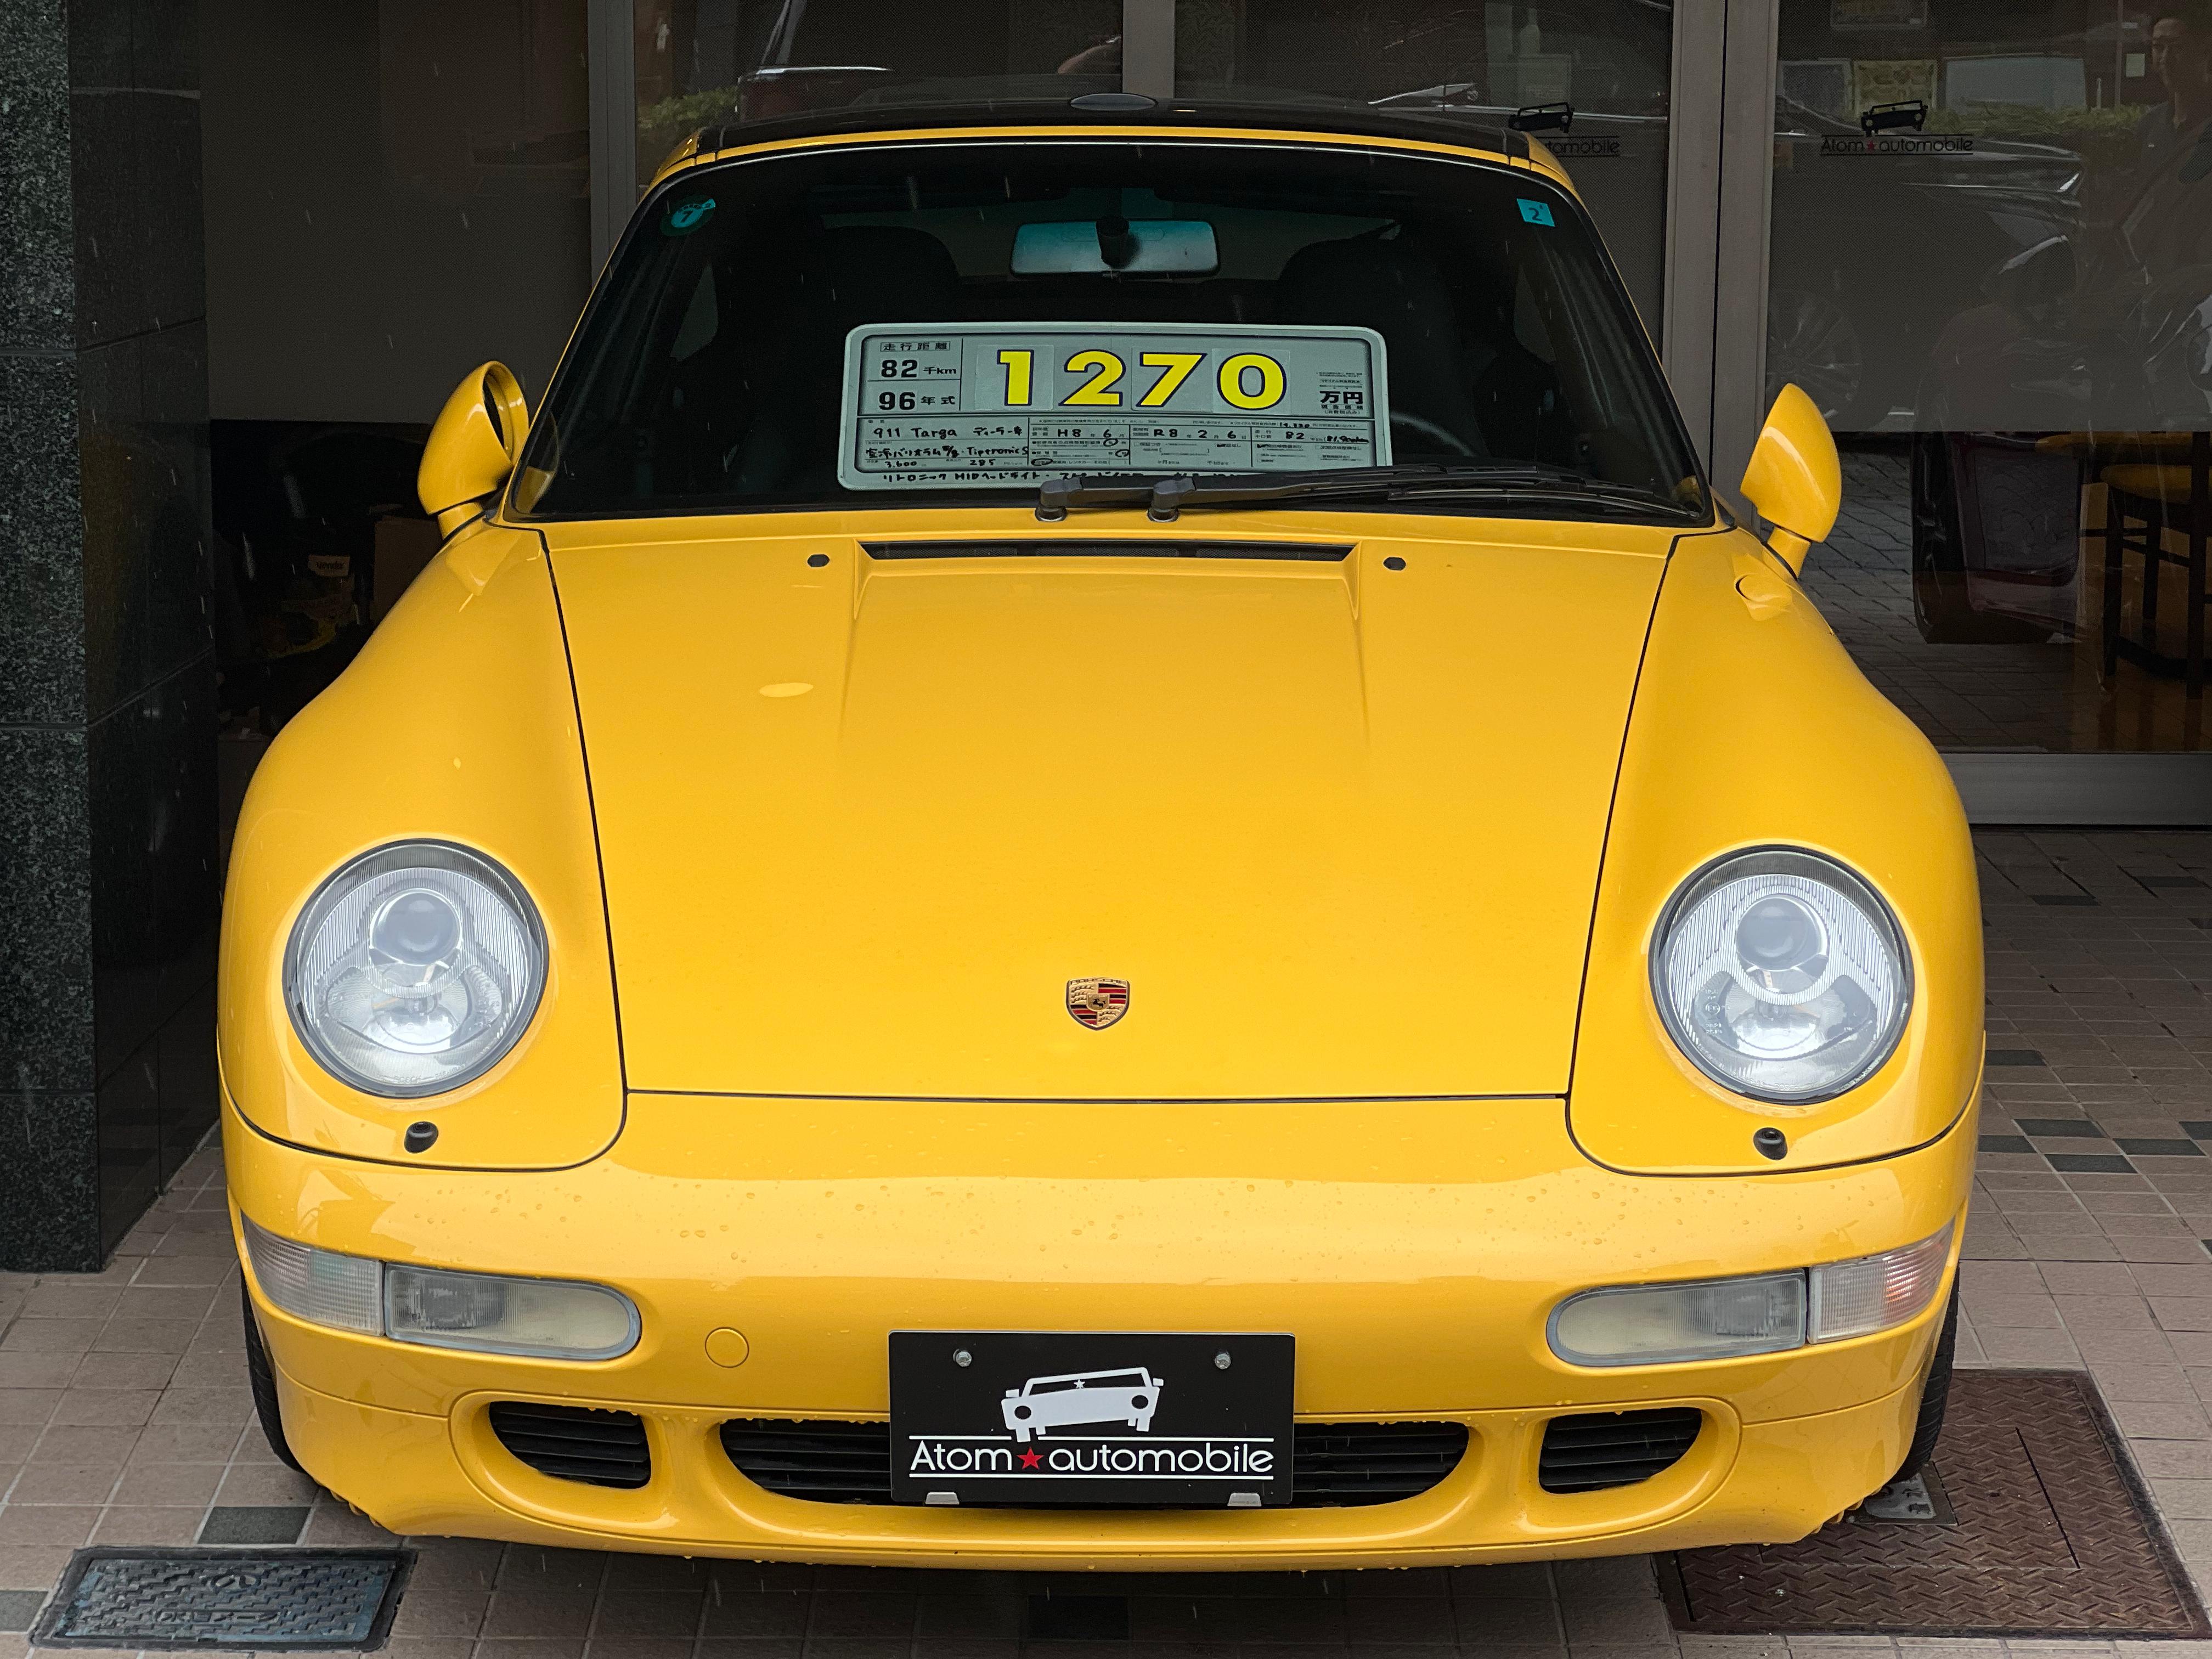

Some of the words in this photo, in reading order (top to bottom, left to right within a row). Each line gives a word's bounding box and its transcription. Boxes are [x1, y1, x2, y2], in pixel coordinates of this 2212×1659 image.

[1546, 139, 1620, 154] tomobile
[1821, 138, 1864, 152] Atom
[1879, 137, 1974, 152] automobile
[680, 210, 694, 223] 7
[1528, 207, 1543, 222] 2
[883, 342, 947, 351] 走行距離
[881, 359, 918, 378] 82
[996, 348, 1288, 411] 1270
[879, 392, 916, 410] 96
[921, 396, 956, 405] 年式
[1319, 391, 1363, 404] 万円
[874, 428, 901, 438] 911
[911, 427, 957, 439] Targa
[1057, 428, 1081, 437] H8
[1103, 428, 1112, 438] 6
[1154, 428, 1178, 438] R8
[1198, 430, 1207, 438] 2
[1227, 431, 1237, 439] 6
[910, 1440, 1012, 1471] Atom
[1048, 1442, 1274, 1472] automobile
